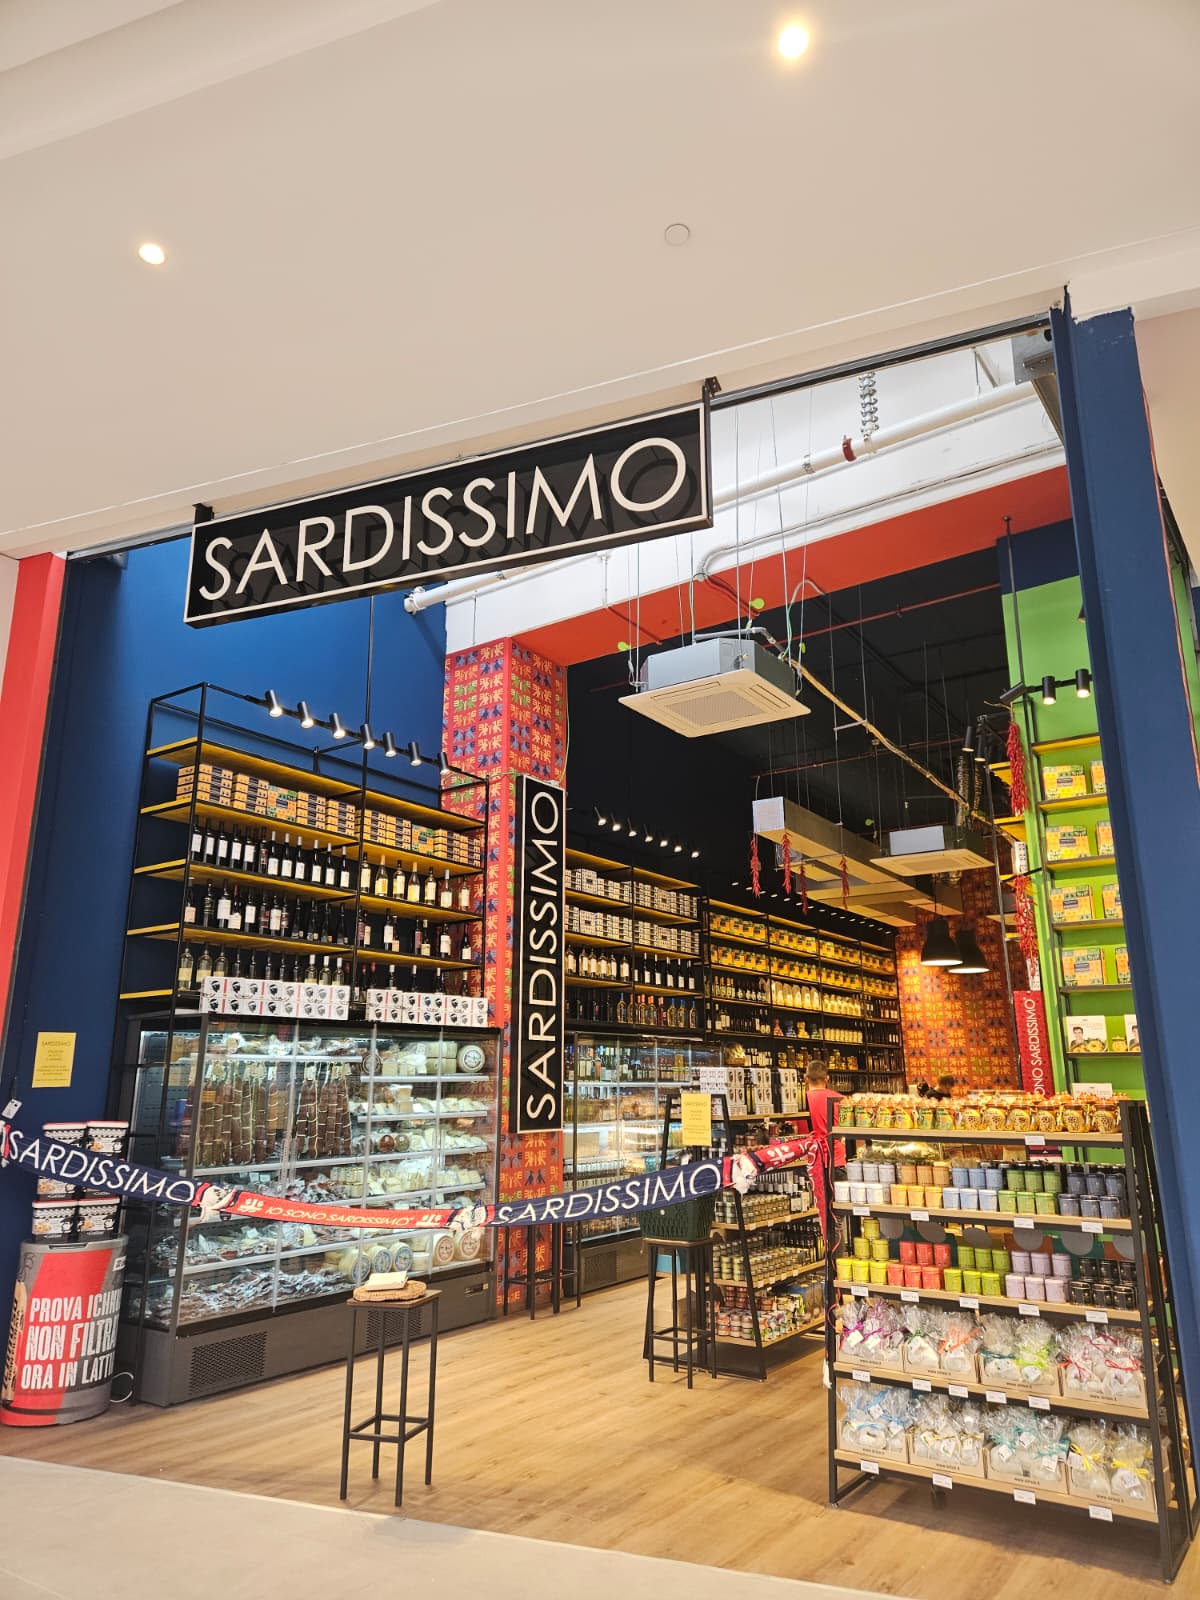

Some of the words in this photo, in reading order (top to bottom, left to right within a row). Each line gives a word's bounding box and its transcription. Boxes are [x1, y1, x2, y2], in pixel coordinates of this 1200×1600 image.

[199, 437, 687, 600] SARDISSIMO
[526, 791, 559, 1120] SARDISSIMO
[1024, 999, 1042, 1066] SARDISSIMO
[9, 1130, 196, 1203] SARDISSIMO
[490, 1163, 723, 1225] SARDISSIMO
[283, 1209, 326, 1220] SONO
[326, 1214, 411, 1227] SARDISSIMO
[28, 1295, 83, 1323] PROVA
[25, 1324, 67, 1361] NON
[20, 1363, 54, 1390] ORA
[58, 1361, 78, 1388] IN
